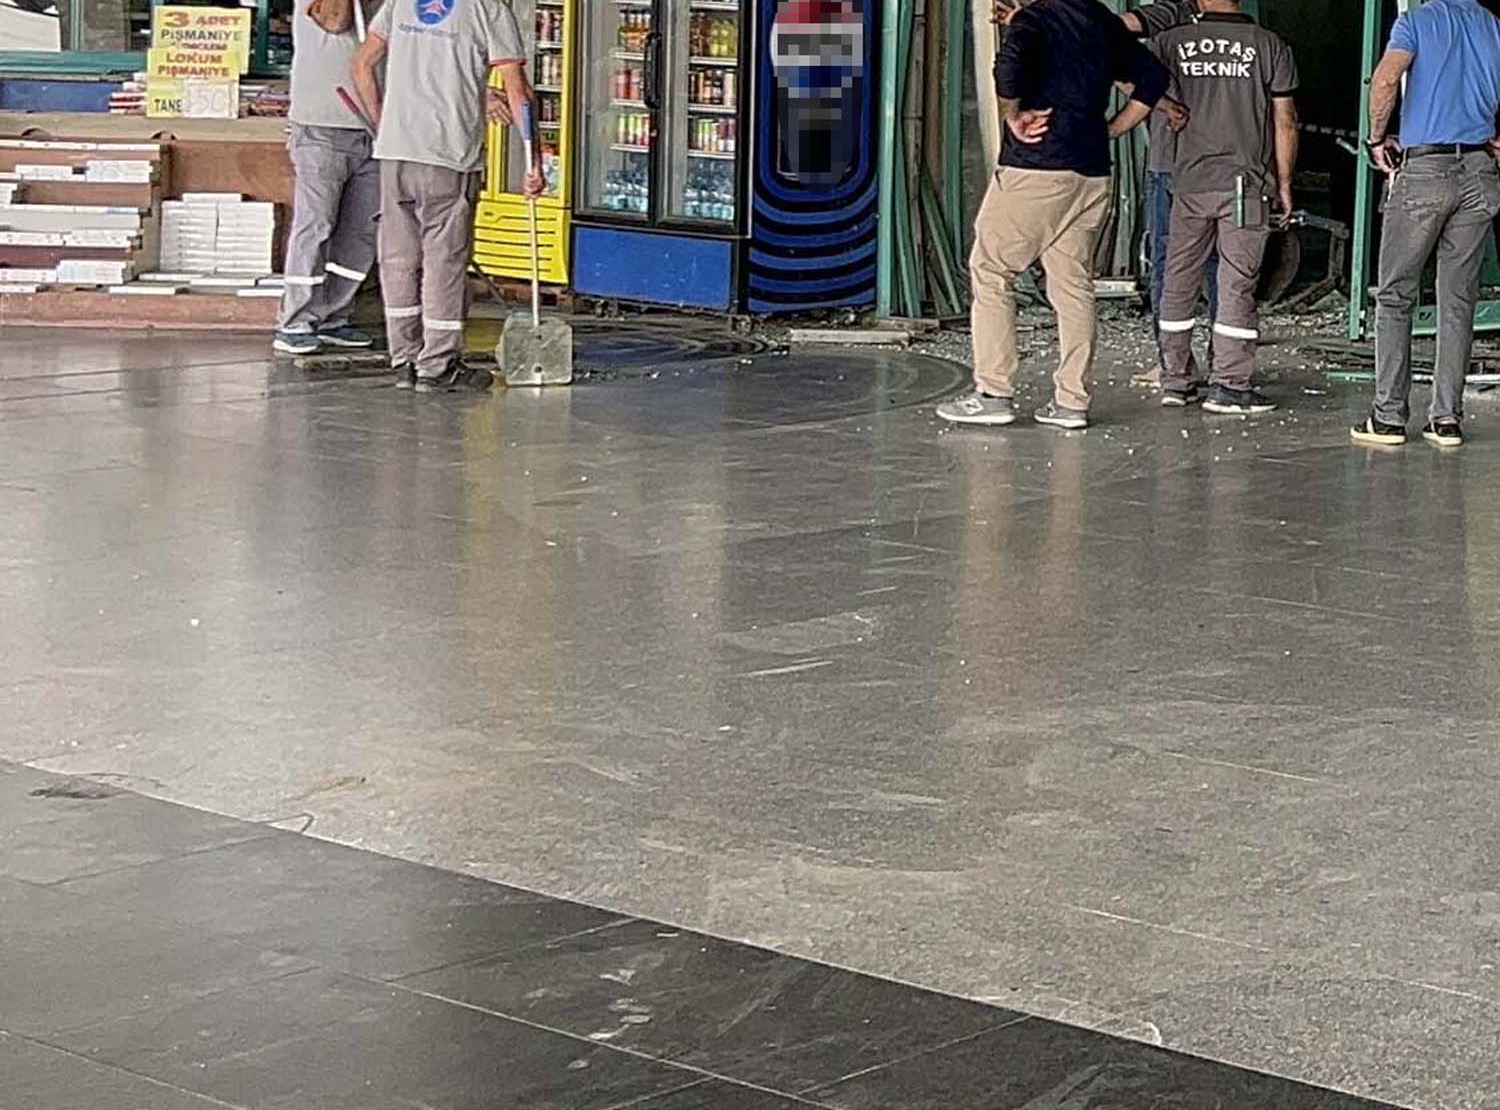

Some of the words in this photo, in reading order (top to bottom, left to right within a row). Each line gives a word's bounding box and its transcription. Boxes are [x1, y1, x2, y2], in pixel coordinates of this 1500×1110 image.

[164, 11, 190, 27] 3
[166, 53, 223, 64] LOKUM
[1180, 59, 1251, 78] TEKNİK
